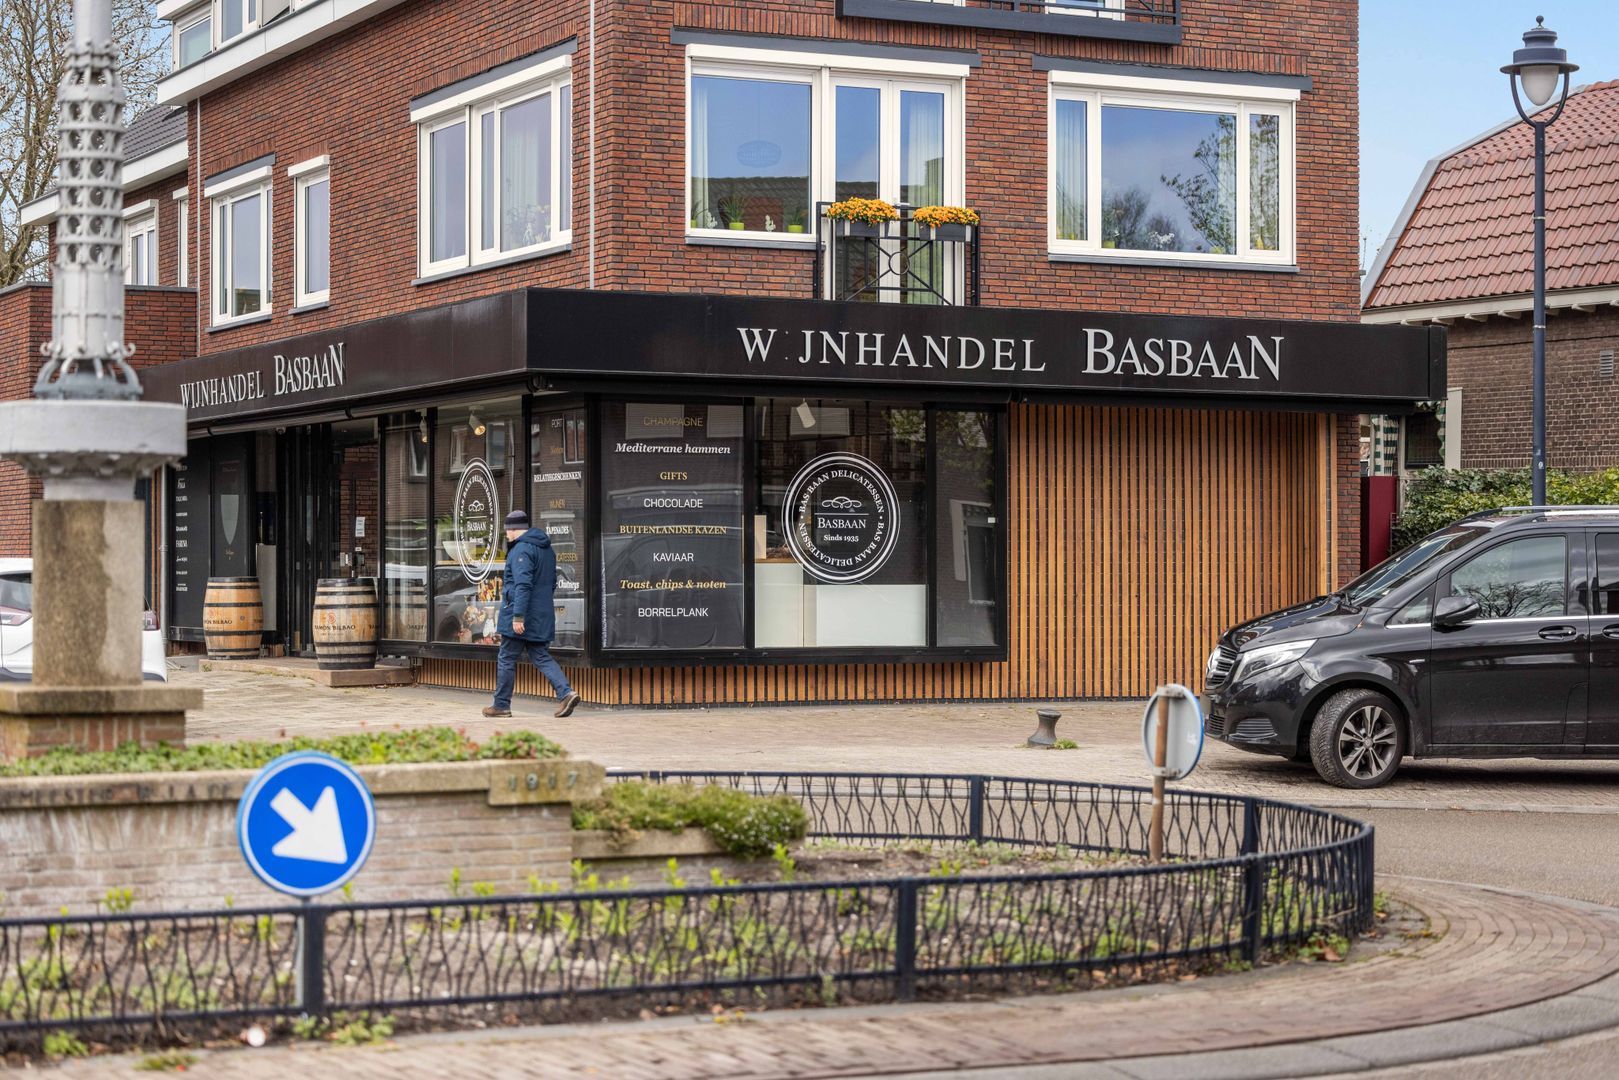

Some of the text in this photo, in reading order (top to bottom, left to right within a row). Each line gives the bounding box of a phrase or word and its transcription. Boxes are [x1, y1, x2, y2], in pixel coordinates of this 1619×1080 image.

[180, 370, 265, 409] WIJNHANDEL
[643, 416, 704, 427] CHAMPAGNE
[615, 443, 731, 454] Mediterrane hammen
[660, 471, 688, 480] GIFTS
[798, 469, 885, 513] BAS BAAN DELICATESSEN
[643, 498, 704, 508] CHOCOLADE
[619, 525, 727, 535] BUITENLANDSE KAZEN
[799, 522, 885, 567] BAS BAAN DELICATESSEN
[653, 552, 695, 562] KAVIAAR
[655, 579, 683, 592] chips
[685, 579, 695, 589] &
[697, 580, 727, 590] noten
[638, 607, 709, 617] BORRELPLANK
